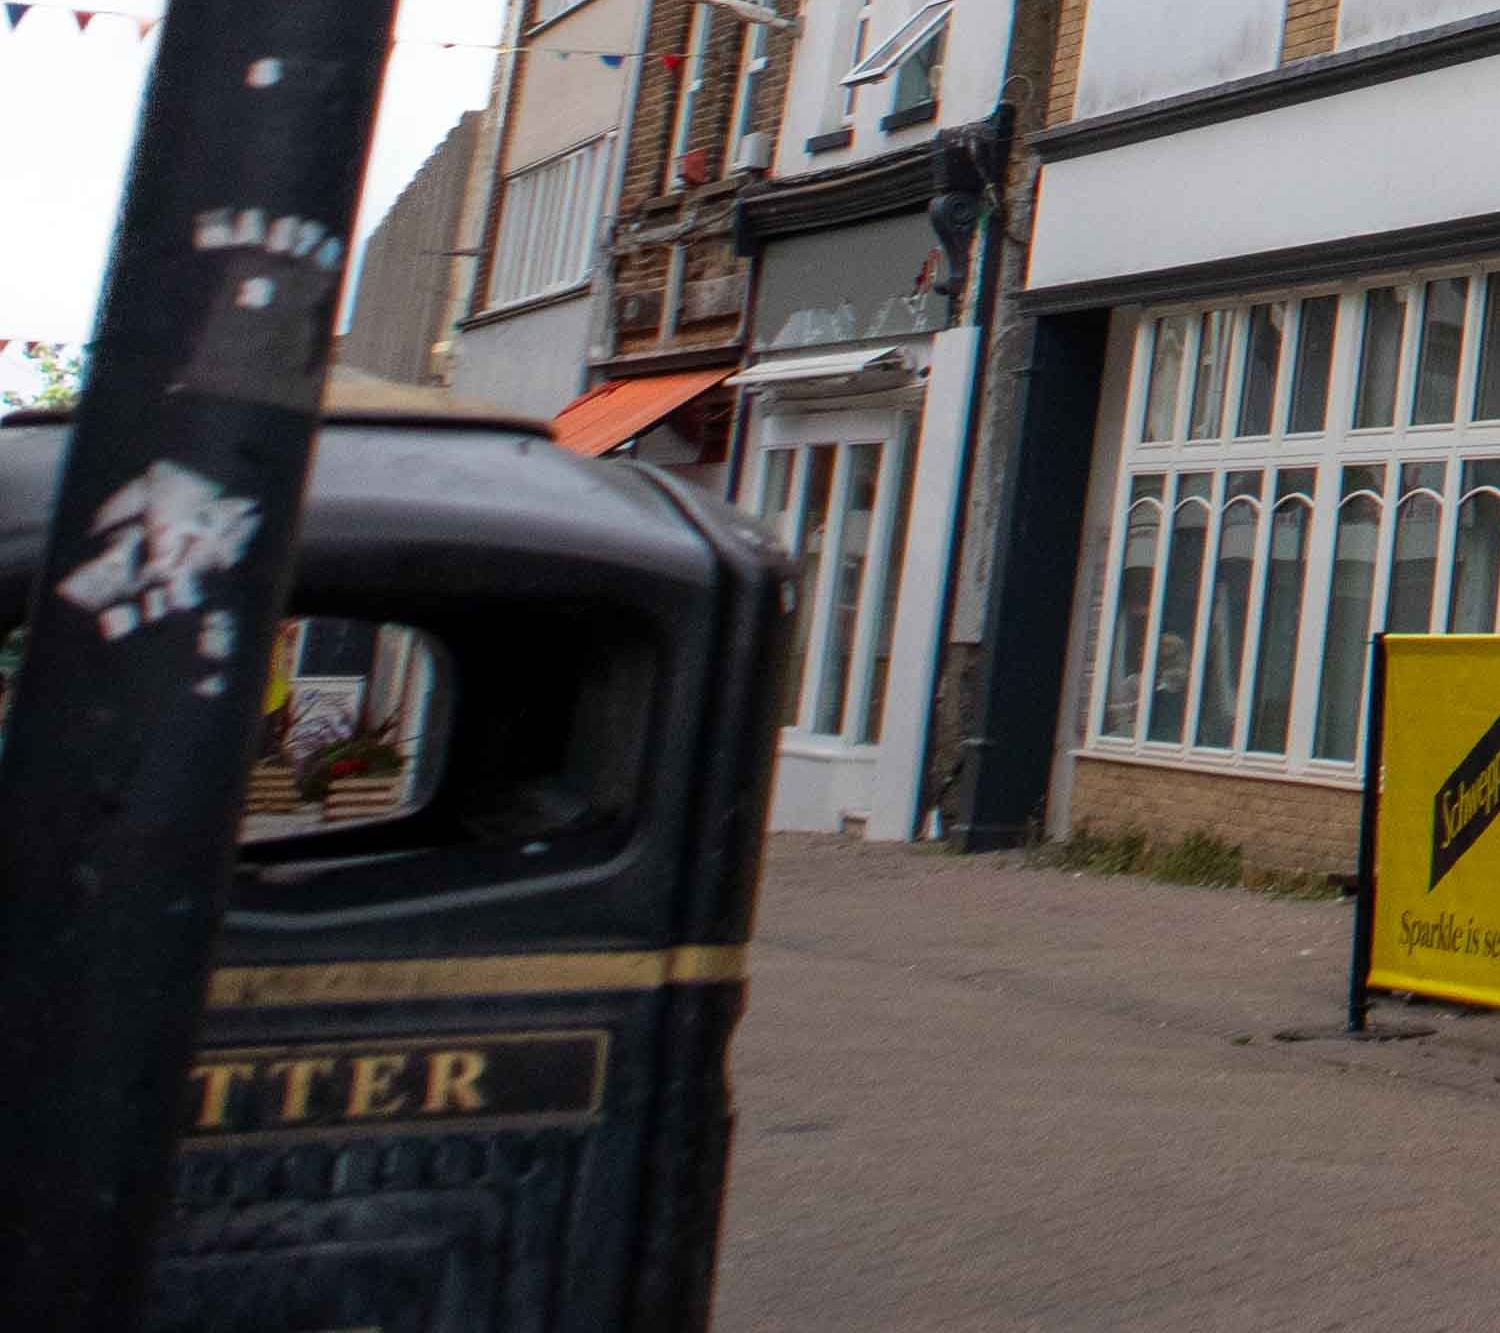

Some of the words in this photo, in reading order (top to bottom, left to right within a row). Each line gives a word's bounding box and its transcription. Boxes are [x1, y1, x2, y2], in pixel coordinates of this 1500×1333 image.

[1400, 909, 1463, 957] Sparkle
[1464, 916, 1483, 955] is
[187, 1049, 488, 1127] TTER
